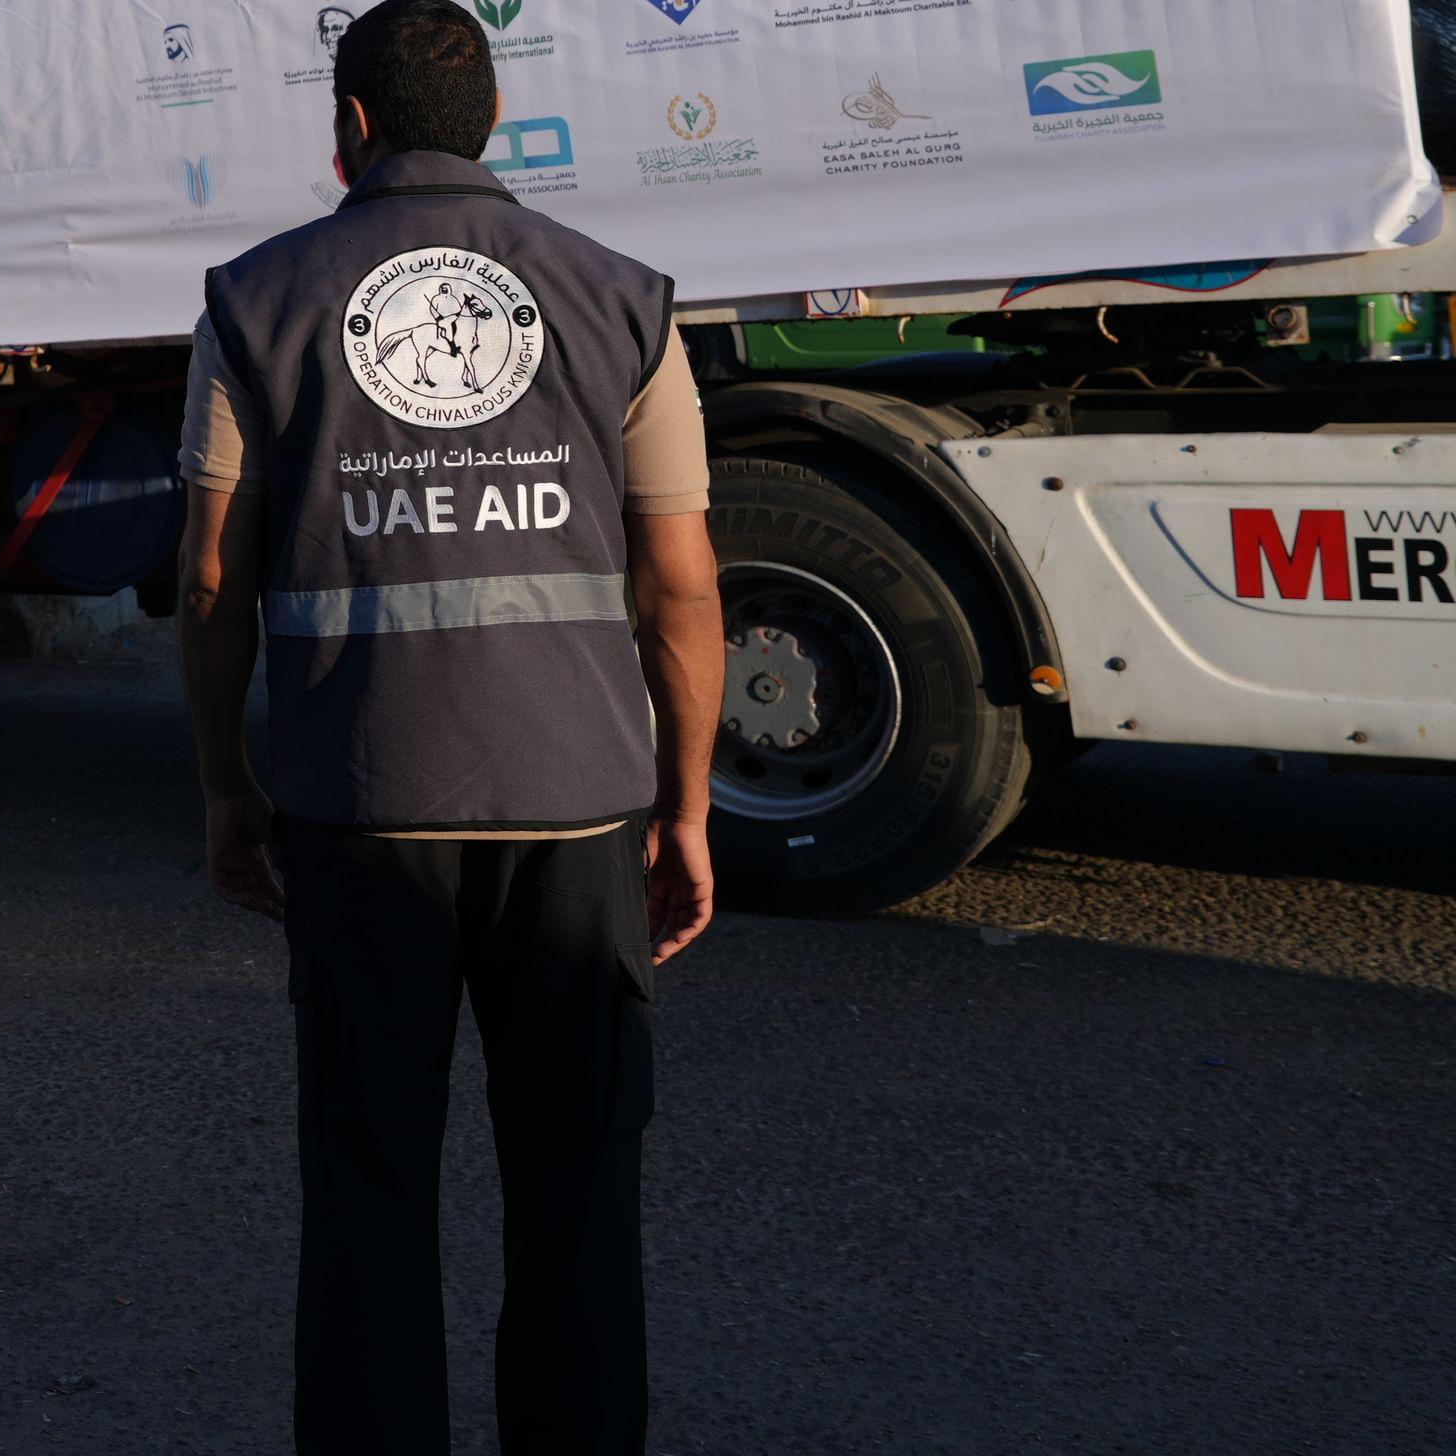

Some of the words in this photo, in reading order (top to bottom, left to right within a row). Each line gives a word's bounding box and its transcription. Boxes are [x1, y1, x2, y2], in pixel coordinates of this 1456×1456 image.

[775, 17, 820, 28] Mohammed
[822, 14, 834, 22] bin
[836, 11, 862, 21] Rashid
[874, 6, 912, 17] Maktoum
[913, 1, 955, 12] Charitable
[509, 46, 554, 59] International
[824, 153, 855, 163] EASA
[860, 149, 900, 160] SALEH
[905, 147, 920, 155] AL
[924, 142, 961, 153] GURG
[825, 163, 877, 175] CHARITY
[882, 155, 963, 169] FOUNDATION
[654, 174, 677, 185] Ihsan
[679, 171, 711, 185] Charity
[713, 166, 762, 180] Association
[527, 183, 578, 194] ASSOCIATION
[409, 252, 475, 273] الفارس
[360, 261, 406, 314] الشهم
[477, 262, 519, 304] عملية
[353, 341, 413, 414] OPERATION
[415, 386, 512, 422] CHIVALROUS
[508, 332, 535, 388] KNIGHT
[339, 448, 436, 478] الإماراتية
[442, 444, 570, 468] المساعدات
[342, 486, 458, 537] UAE
[474, 482, 571, 531] AID
[1229, 508, 1456, 603] MER
